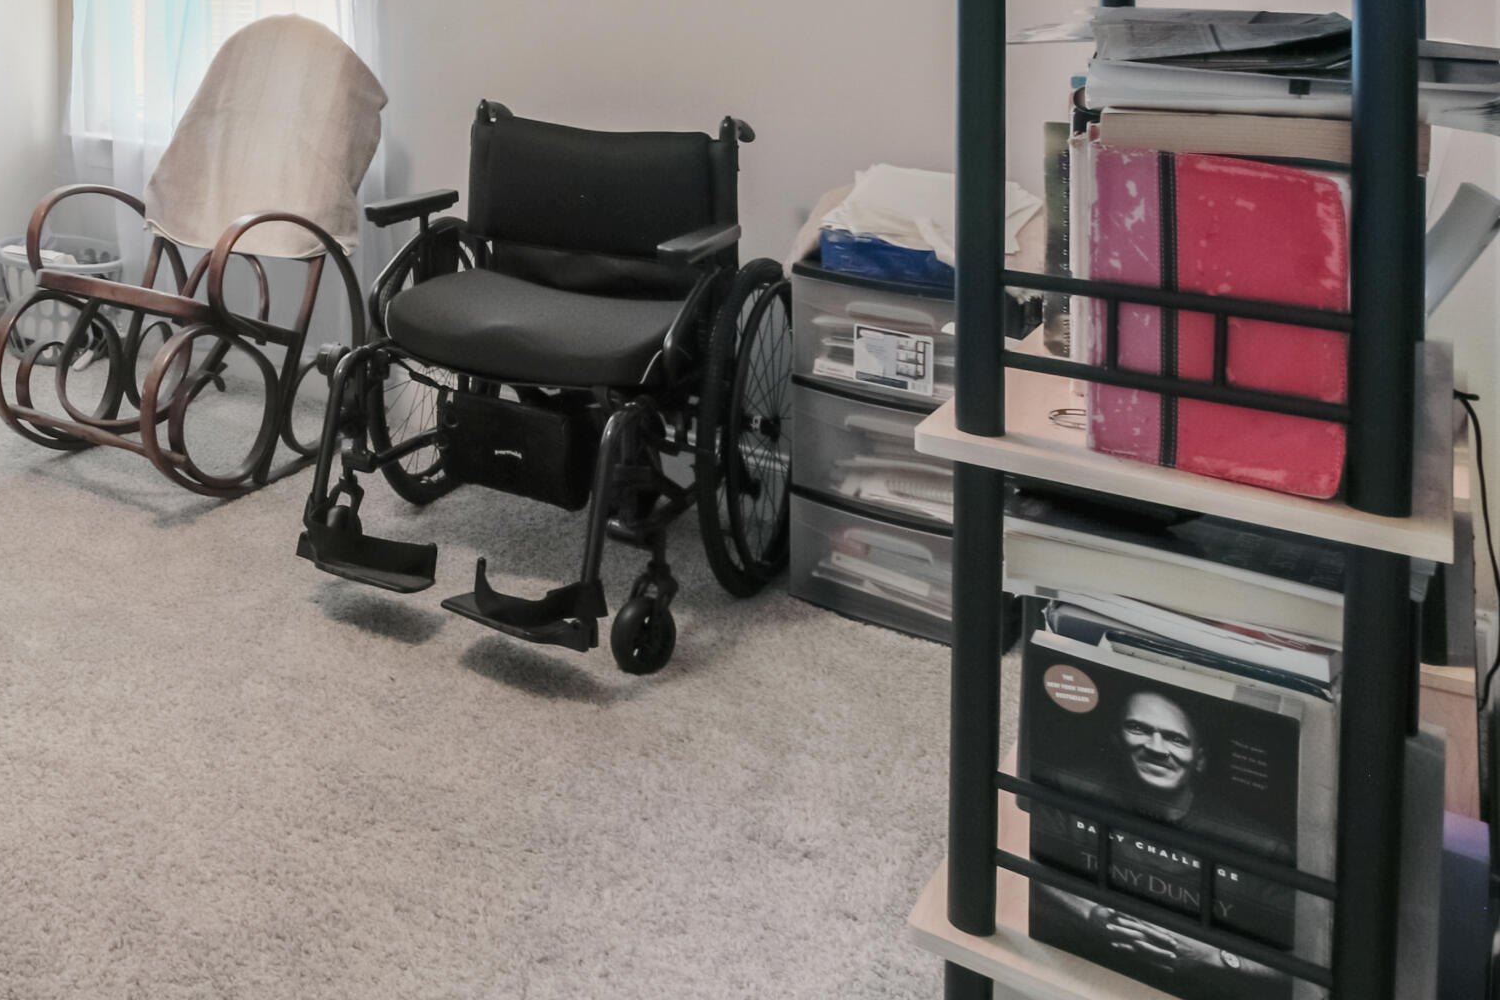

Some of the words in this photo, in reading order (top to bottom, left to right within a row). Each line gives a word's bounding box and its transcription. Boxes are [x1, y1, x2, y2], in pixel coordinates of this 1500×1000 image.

[1061, 673, 1074, 682] THE
[1045, 681, 1061, 689] NEW
[1060, 683, 1077, 692] YORK
[1055, 691, 1090, 703] BESTSELLER
[1076, 820, 1125, 843] DALY
[1135, 841, 1239, 883] CHALLEGE
[1081, 851, 1142, 887] TNY
[1149, 874, 1233, 918] DUNY
